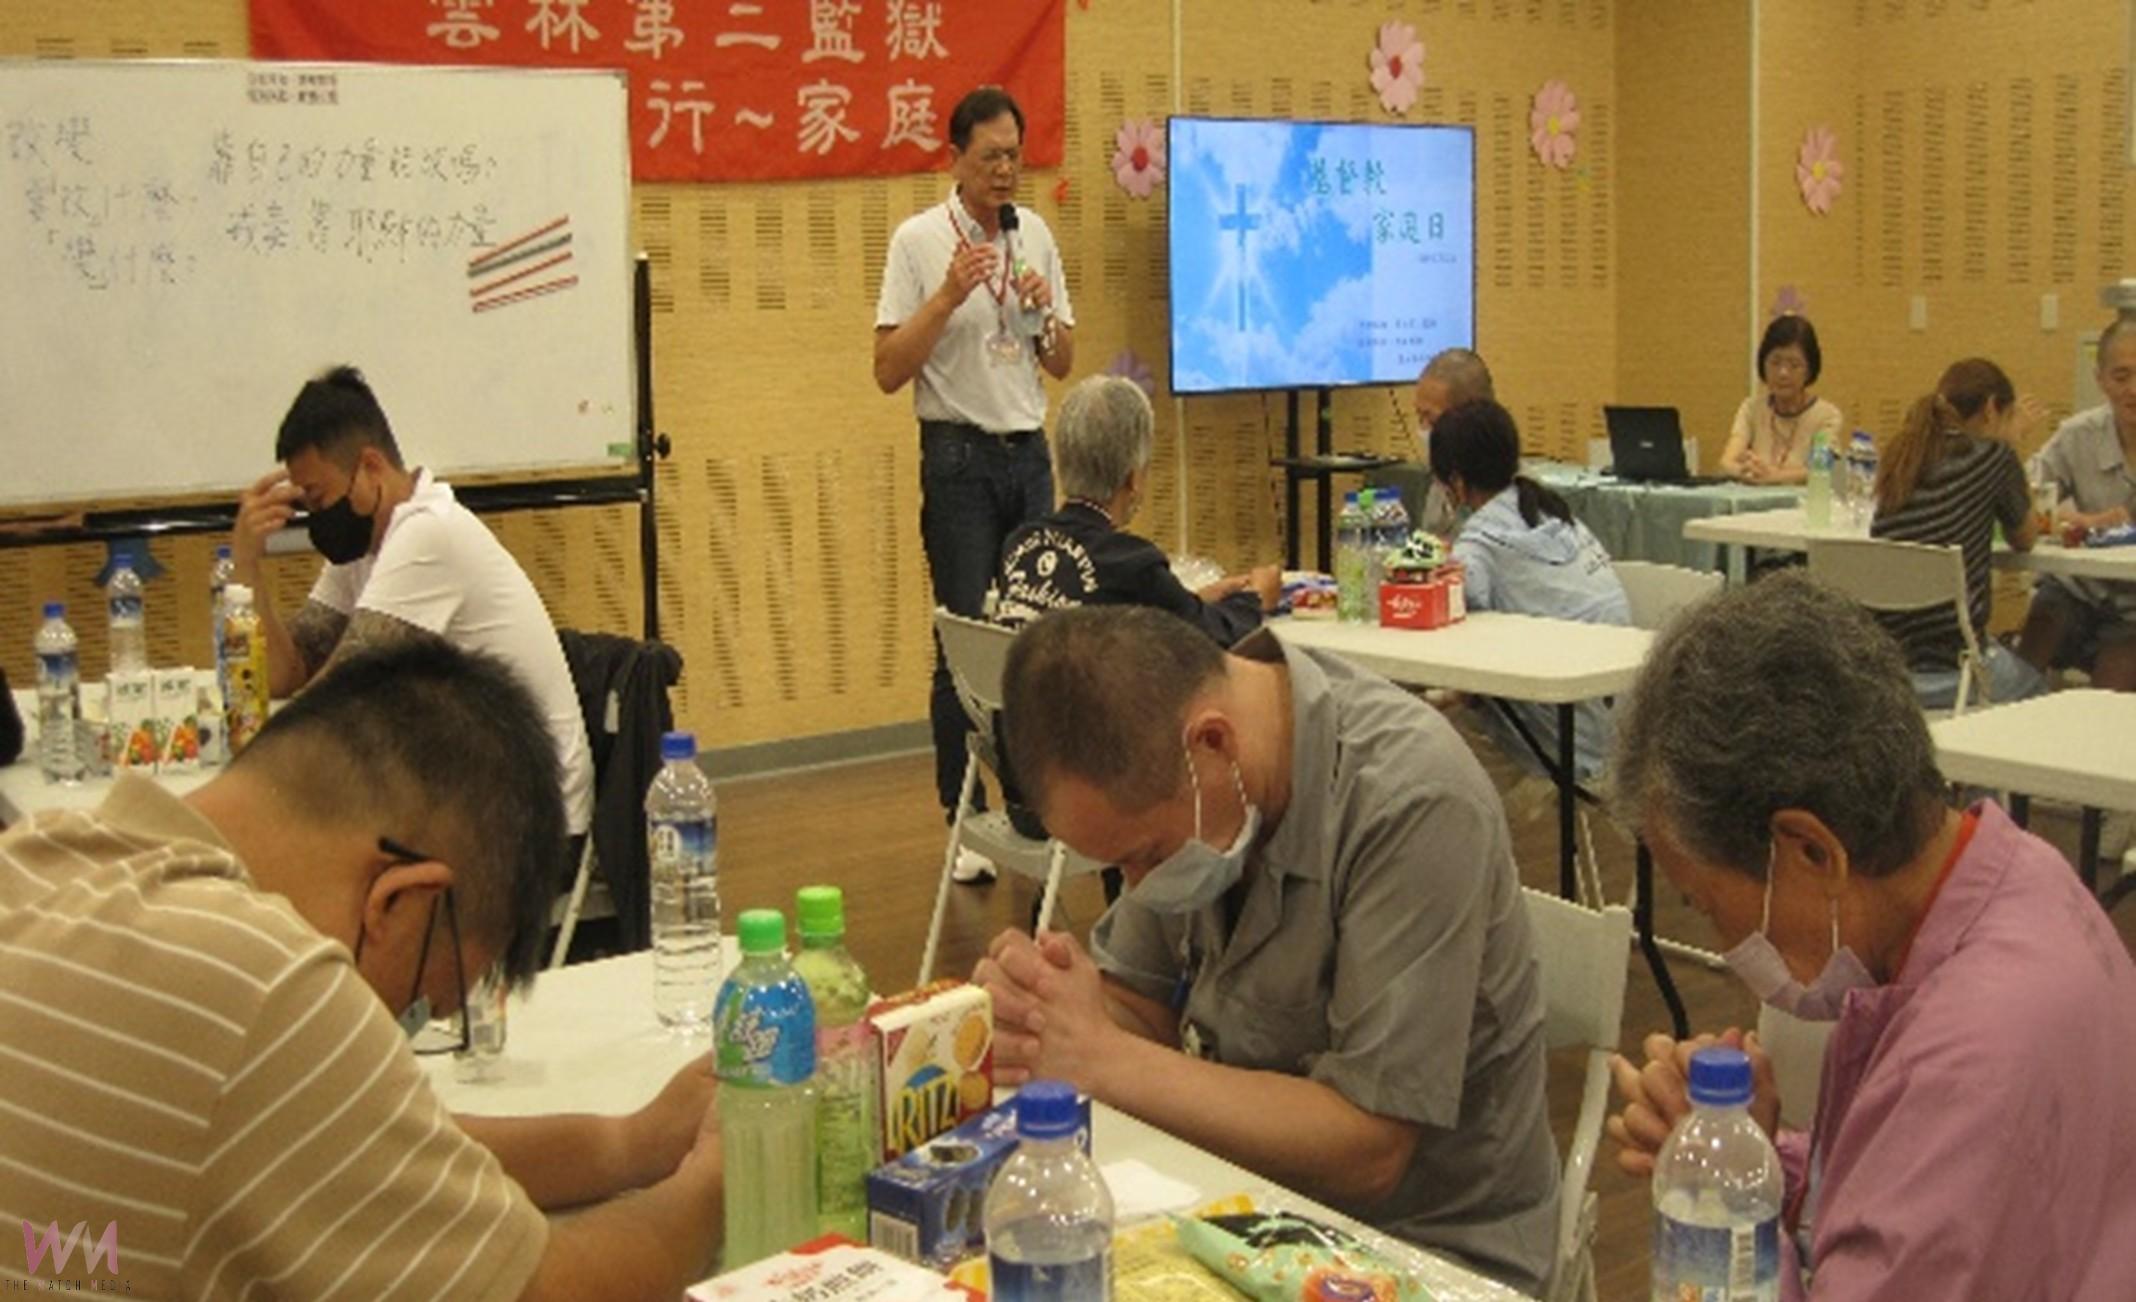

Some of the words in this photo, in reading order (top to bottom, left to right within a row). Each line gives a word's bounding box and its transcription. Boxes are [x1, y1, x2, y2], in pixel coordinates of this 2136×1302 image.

[646, 79, 1003, 156] 行~家庭
[887, 1073, 961, 1156] RITZ
